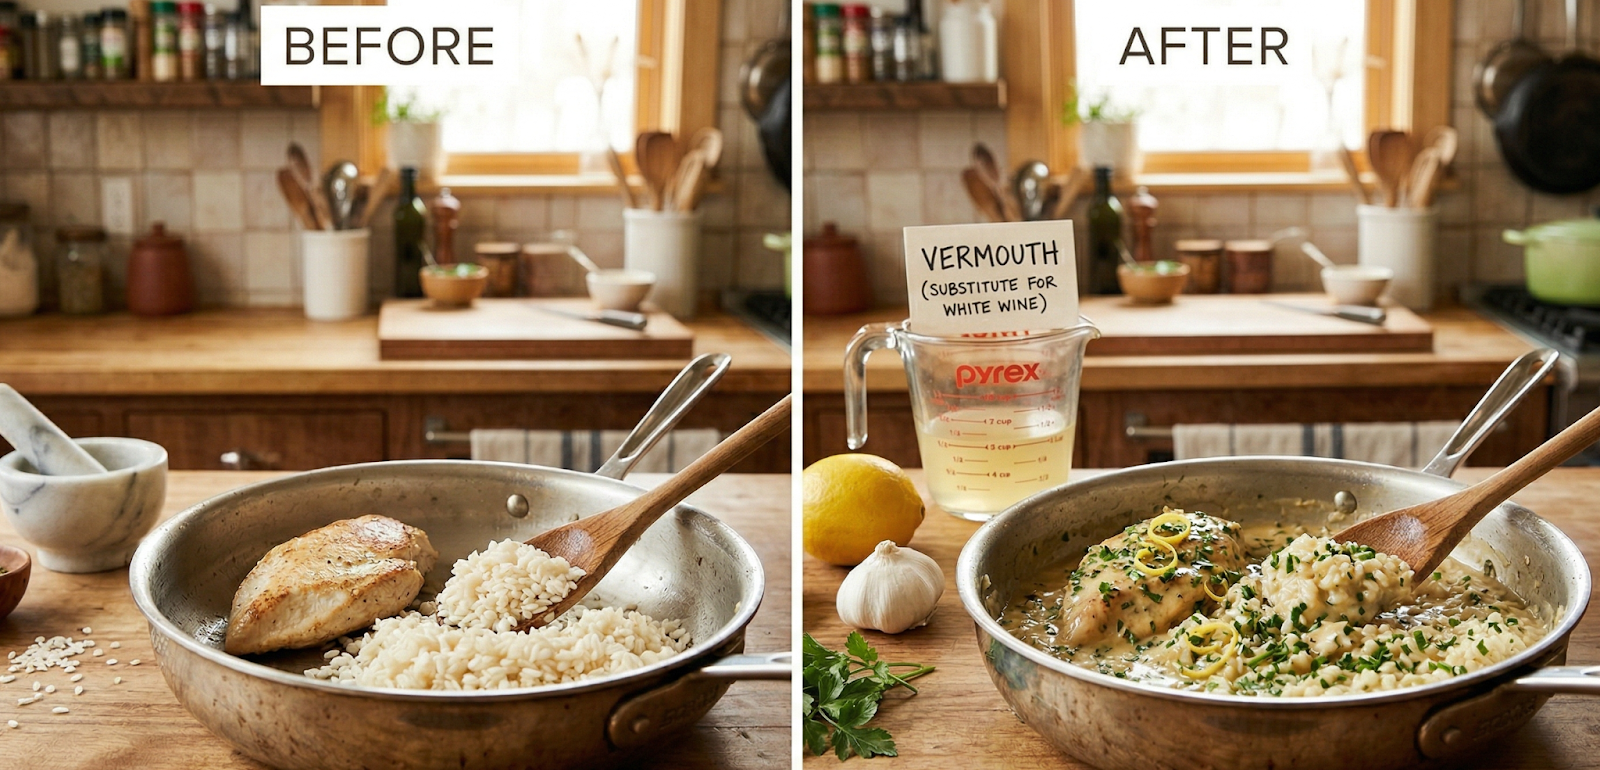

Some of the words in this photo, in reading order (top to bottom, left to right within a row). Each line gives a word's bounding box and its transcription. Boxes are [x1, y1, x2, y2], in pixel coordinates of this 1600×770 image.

[921, 239, 1059, 271] VERMOUTH
[921, 277, 1018, 301] (SUBSTITUTE
[1027, 275, 1058, 290] FOR
[943, 300, 991, 317] WHITE
[998, 293, 1047, 314] WINE)
[956, 362, 1040, 389] pyrex
[996, 418, 1012, 426] cup
